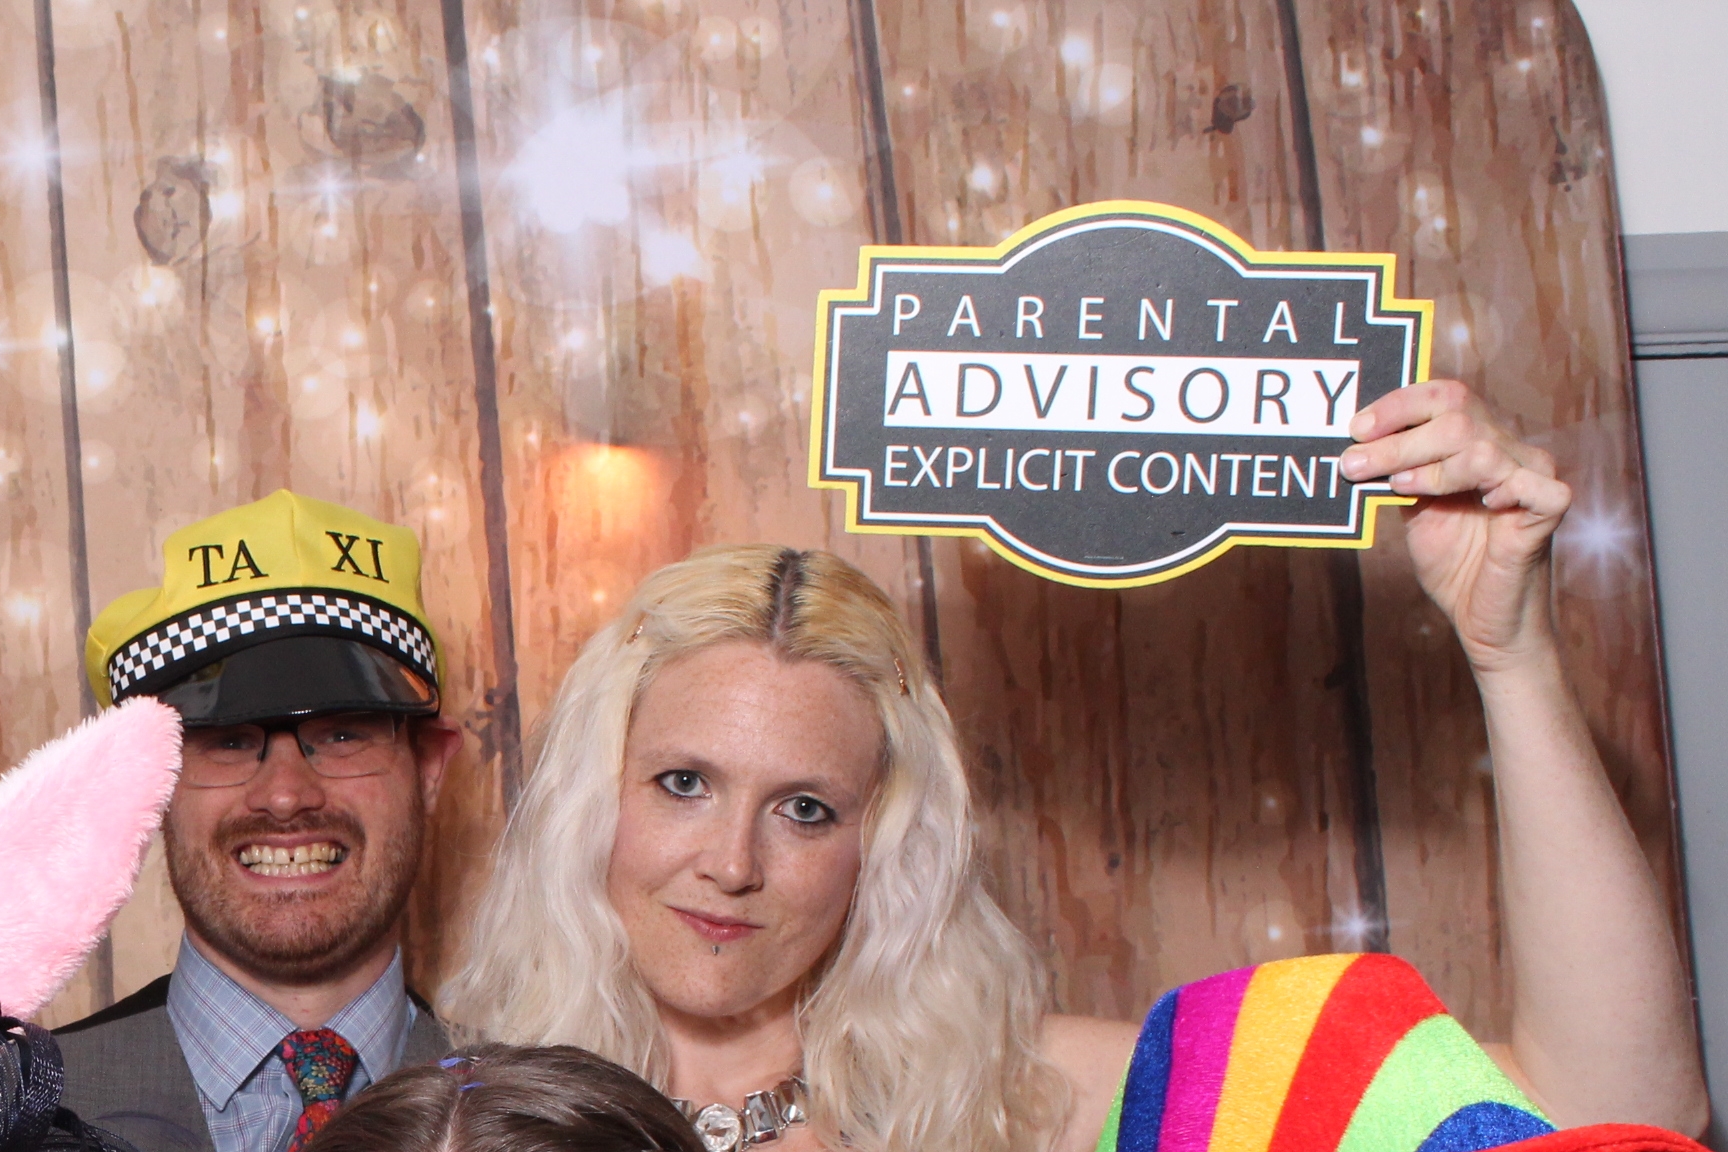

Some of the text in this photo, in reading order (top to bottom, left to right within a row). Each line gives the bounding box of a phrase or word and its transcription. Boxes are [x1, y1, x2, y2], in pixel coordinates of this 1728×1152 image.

[891, 293, 1359, 345] PARENTAL
[886, 361, 1358, 427] ADVISORY
[883, 445, 1341, 499] EXPLICIT CONTENT
